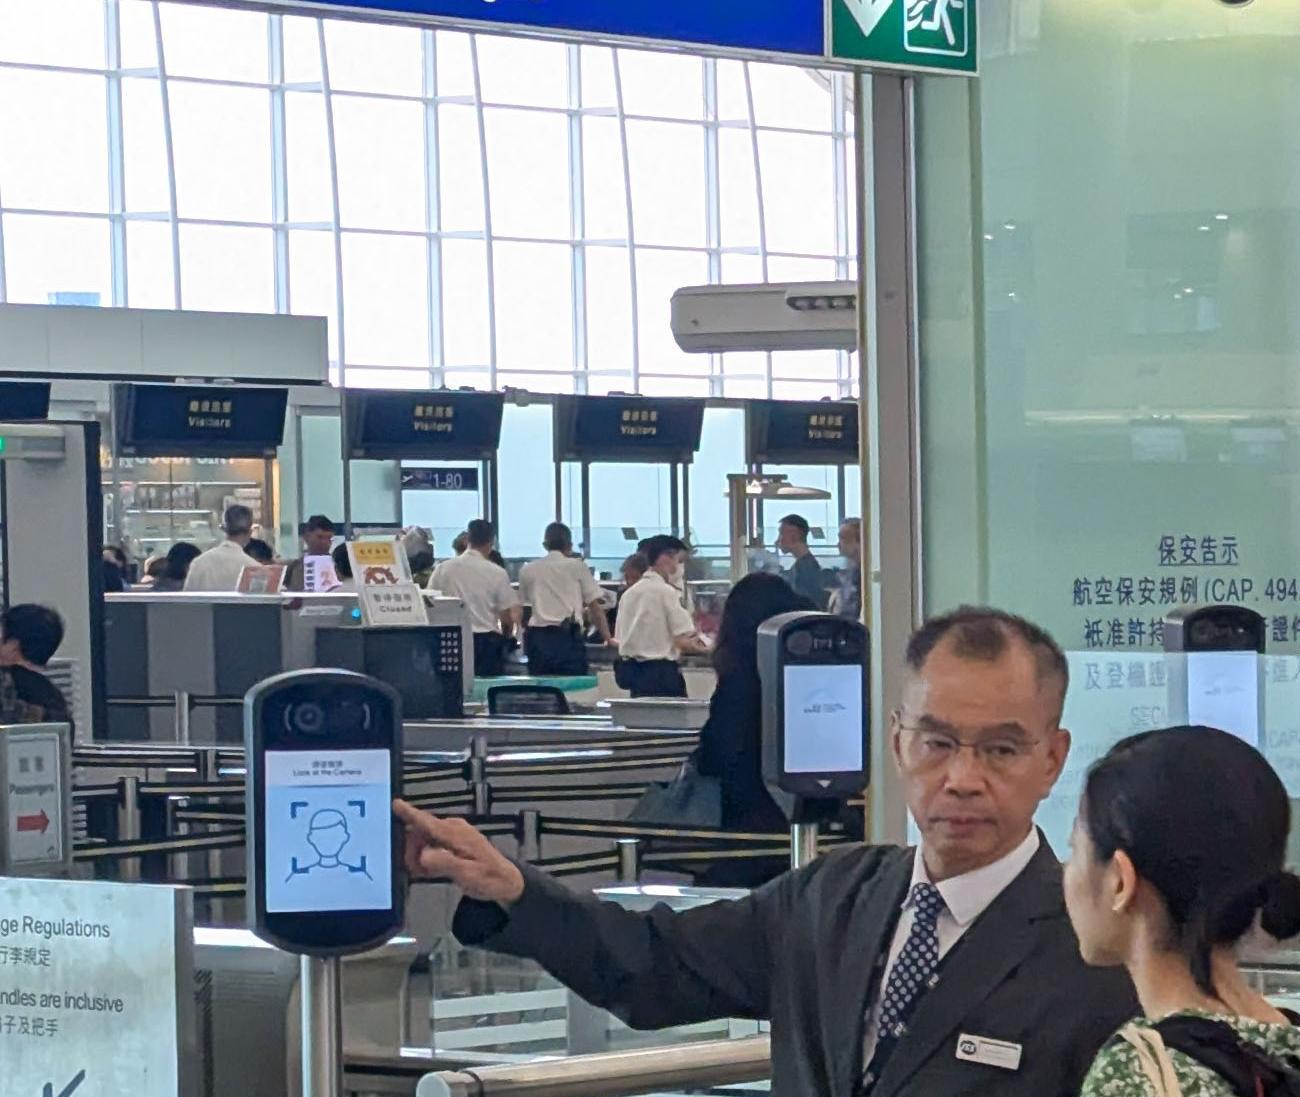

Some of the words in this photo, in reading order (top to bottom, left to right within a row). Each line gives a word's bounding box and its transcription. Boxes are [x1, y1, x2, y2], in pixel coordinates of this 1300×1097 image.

[188, 415, 231, 429] Visitors
[413, 420, 454, 433] Visitors
[432, 472, 463, 490] 1-80
[1158, 535, 1240, 565] 保安告示
[1072, 576, 1199, 607] 航空保安規例
[1204, 578, 1257, 603] (CAP.
[22, 915, 111, 940] Regulations
[0, 989, 37, 1008] ndles
[39, 993, 62, 1009] are
[64, 991, 124, 1013] inclusive
[0, 1014, 60, 1038] 子及把手
